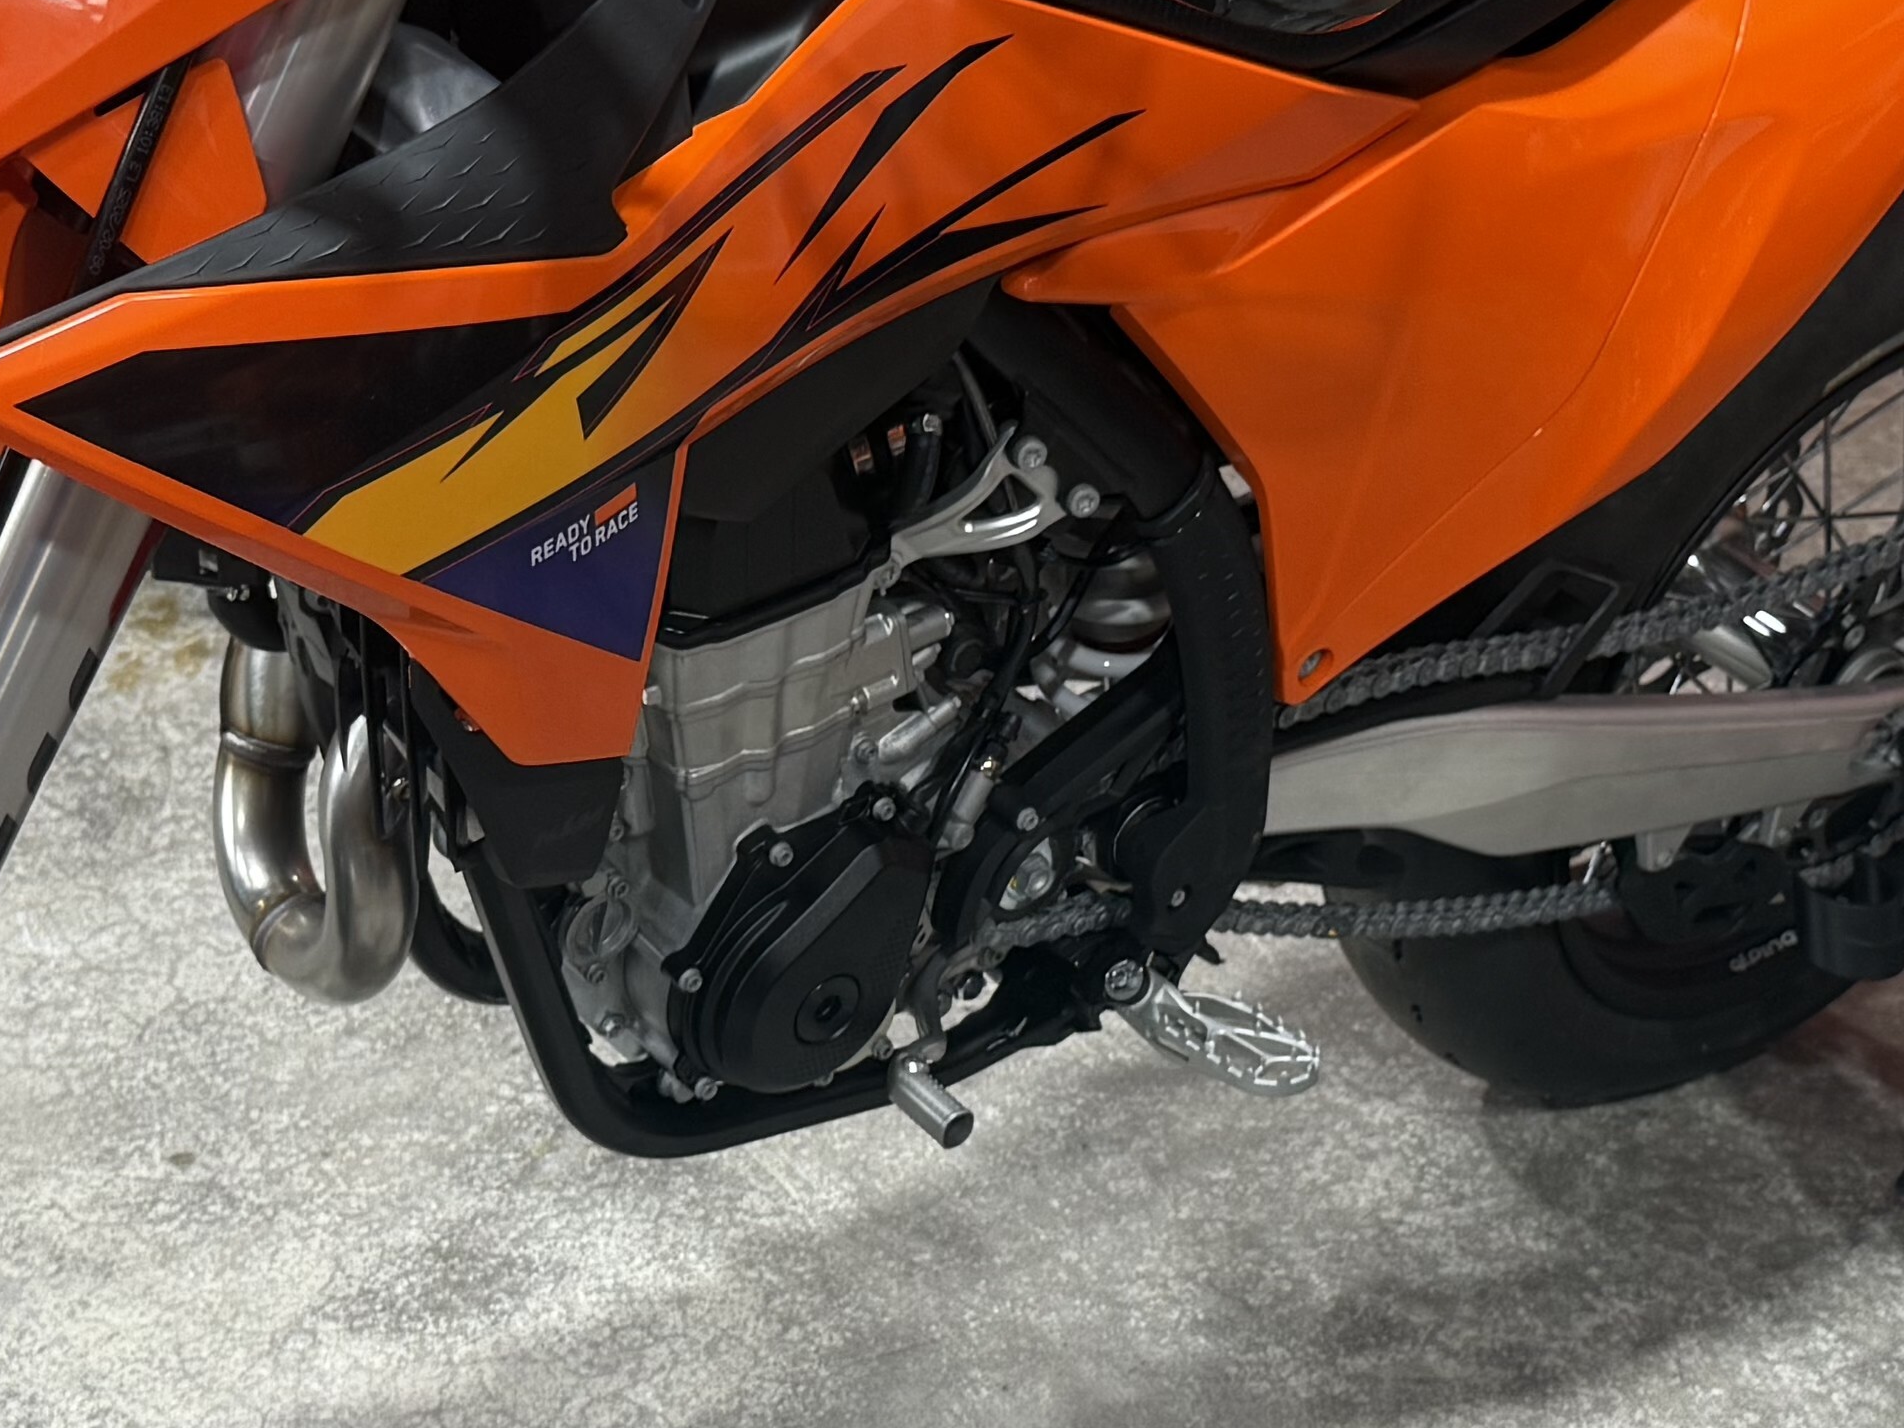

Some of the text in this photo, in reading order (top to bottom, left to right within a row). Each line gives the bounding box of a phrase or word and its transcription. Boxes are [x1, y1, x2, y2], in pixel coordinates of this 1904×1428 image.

[530, 513, 591, 567] READY
[568, 501, 639, 562] TO RACE
